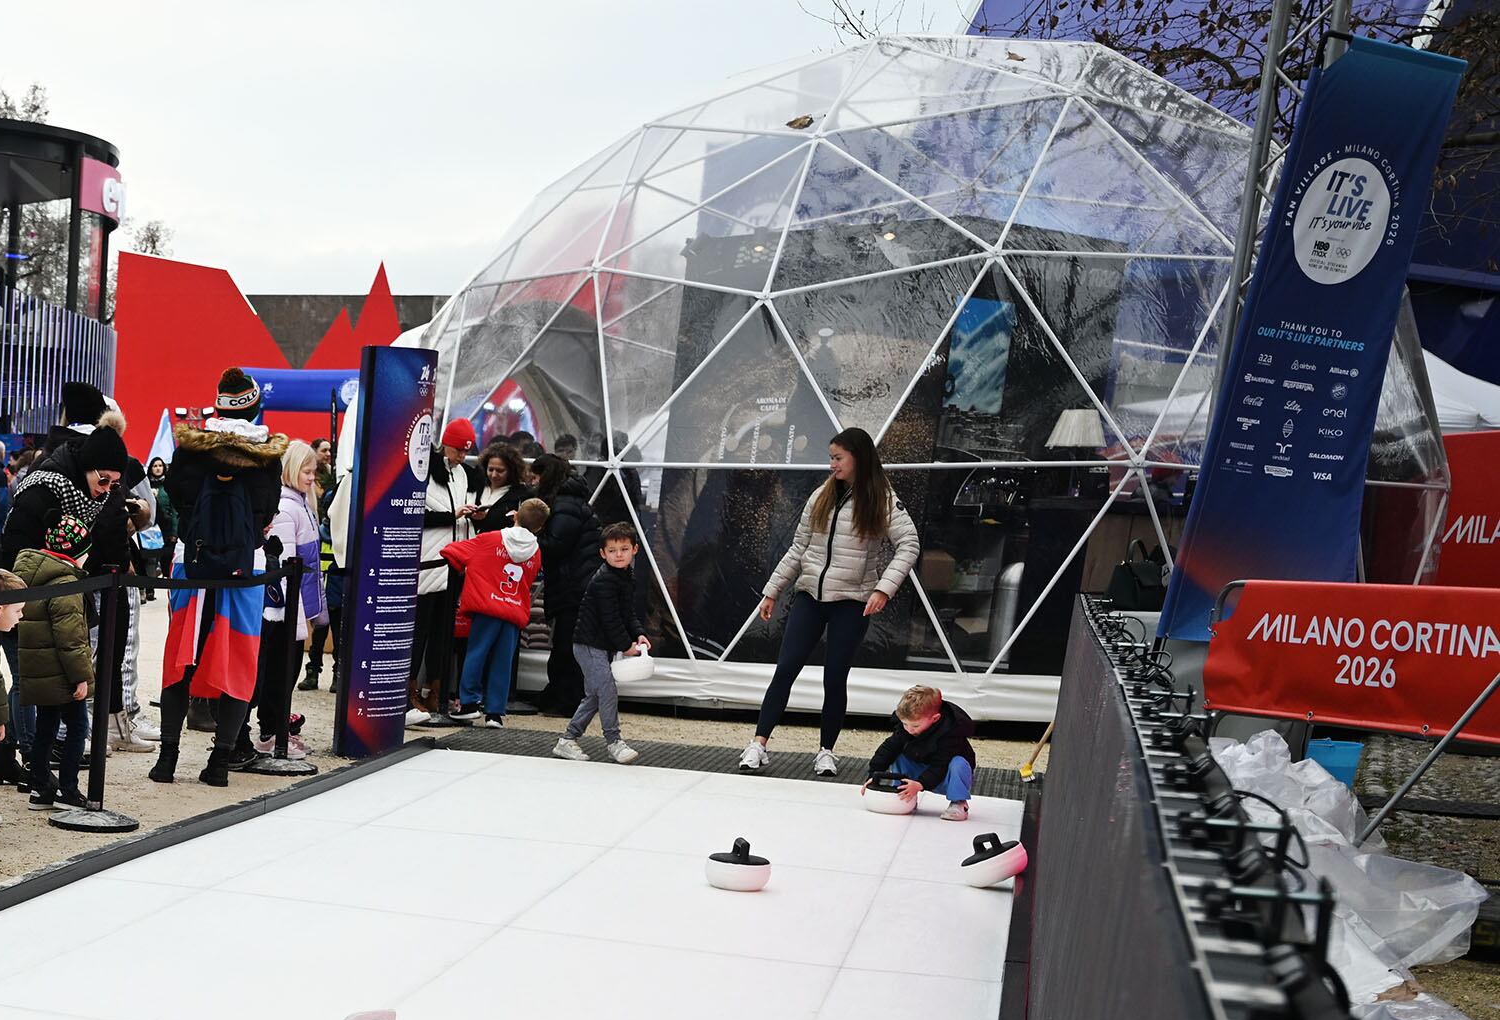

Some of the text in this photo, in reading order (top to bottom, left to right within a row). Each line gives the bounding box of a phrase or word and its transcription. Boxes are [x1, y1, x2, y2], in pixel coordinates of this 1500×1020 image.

[1326, 170, 1368, 198] IT'S
[1285, 200, 1297, 227] FAN
[1295, 152, 1332, 195] VILLAGE
[1345, 144, 1380, 160] MILANO
[1386, 215, 1400, 246] 2026
[1326, 194, 1373, 221] LIVE
[1325, 219, 1352, 232] your
[1313, 240, 1330, 252] HBO
[1311, 249, 1328, 259] max
[1280, 320, 1343, 338] THANK YOU TO
[1257, 326, 1365, 351] OUR IT'S LIVE PARTNERS
[1258, 353, 1273, 363] a2a
[1299, 362, 1317, 371] airbnb
[1329, 366, 1350, 376] Allianz
[229, 389, 258, 406] COLD
[1284, 400, 1302, 414] Lilly
[1322, 408, 1348, 418] enel
[1318, 428, 1344, 436] KIKO
[464, 440, 472, 450] 3
[1308, 452, 1344, 461] SALOMON
[1312, 471, 1332, 480] VISA
[1442, 515, 1500, 544] MILA
[500, 563, 523, 597] 3
[1247, 613, 1500, 658] MILANO CORTINA
[1335, 655, 1397, 688] 2026
